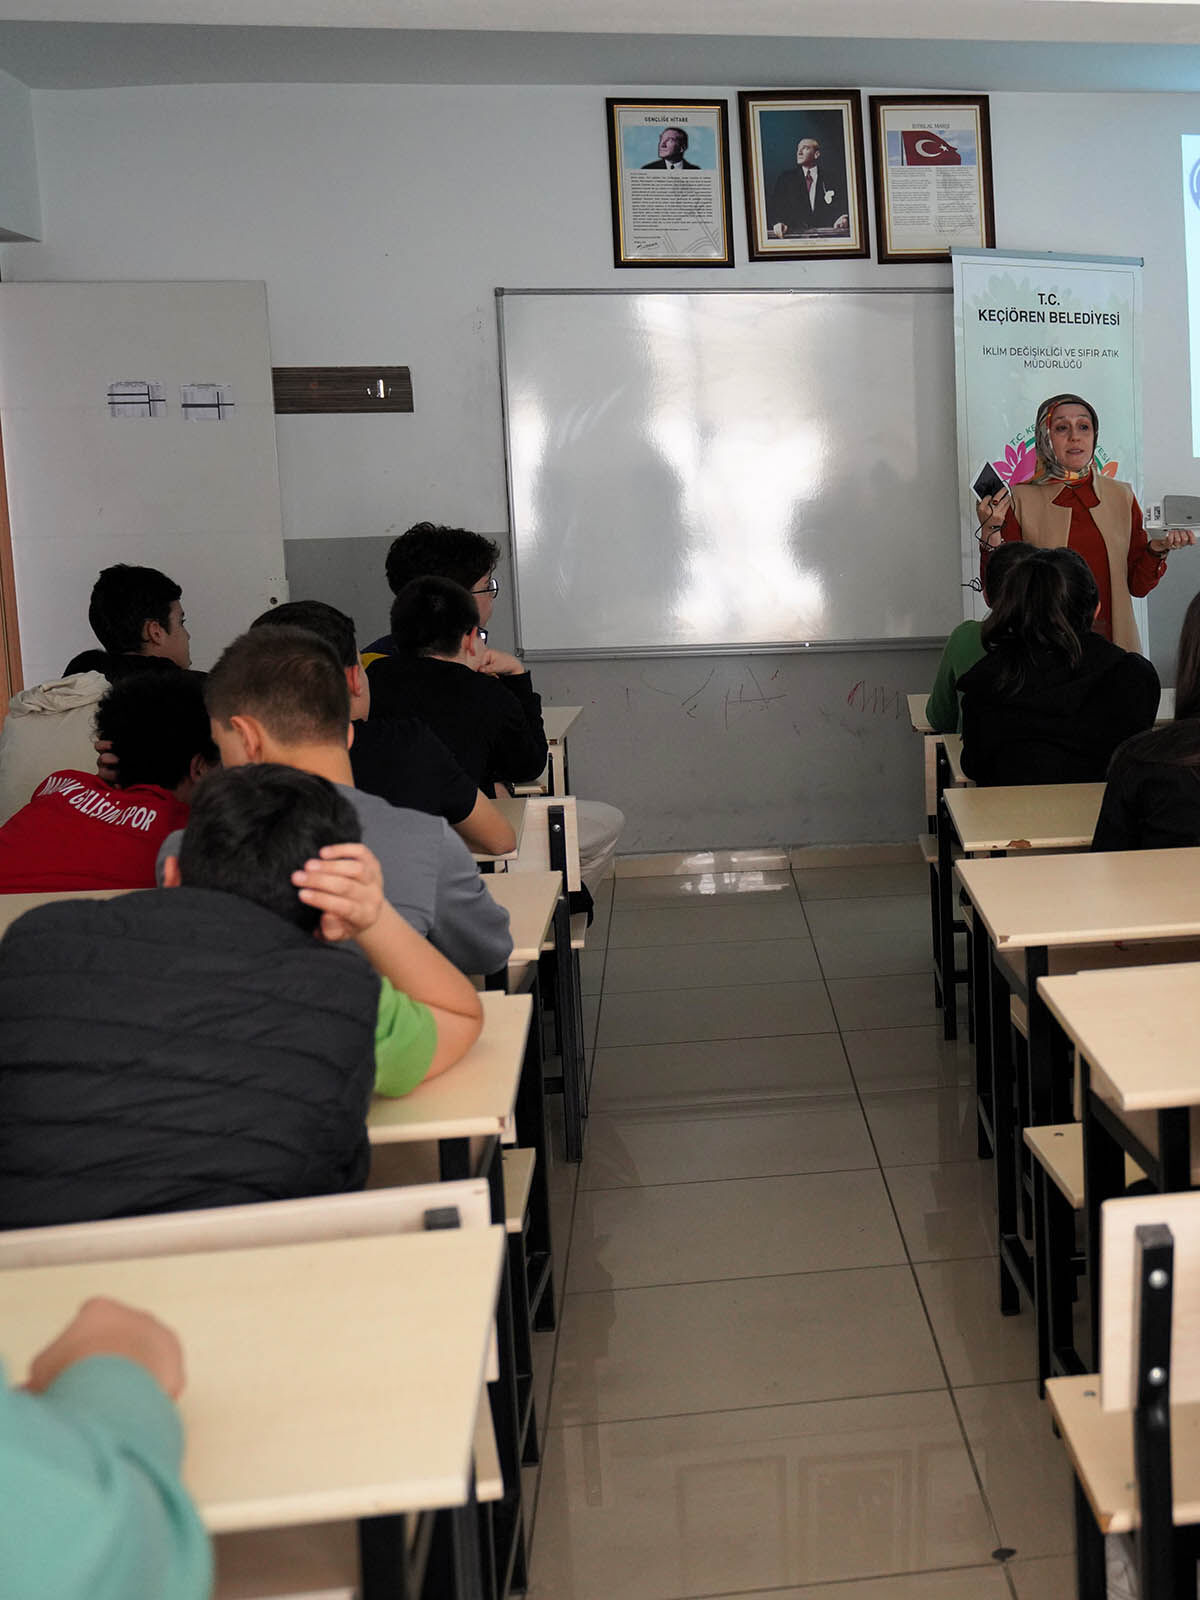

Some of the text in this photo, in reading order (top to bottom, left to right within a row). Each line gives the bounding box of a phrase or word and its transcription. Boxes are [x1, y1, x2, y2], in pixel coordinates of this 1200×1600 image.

[1038, 293, 1060, 306] T.C.
[978, 308, 1120, 326] KEÇİÖREN BELEDİYESİ
[982, 345, 1119, 360] İKLİM DEĞİŞİKLİĞİ VE SIFIR ATIK
[1023, 359, 1083, 370] MÜDÜRLÜĞÜ
